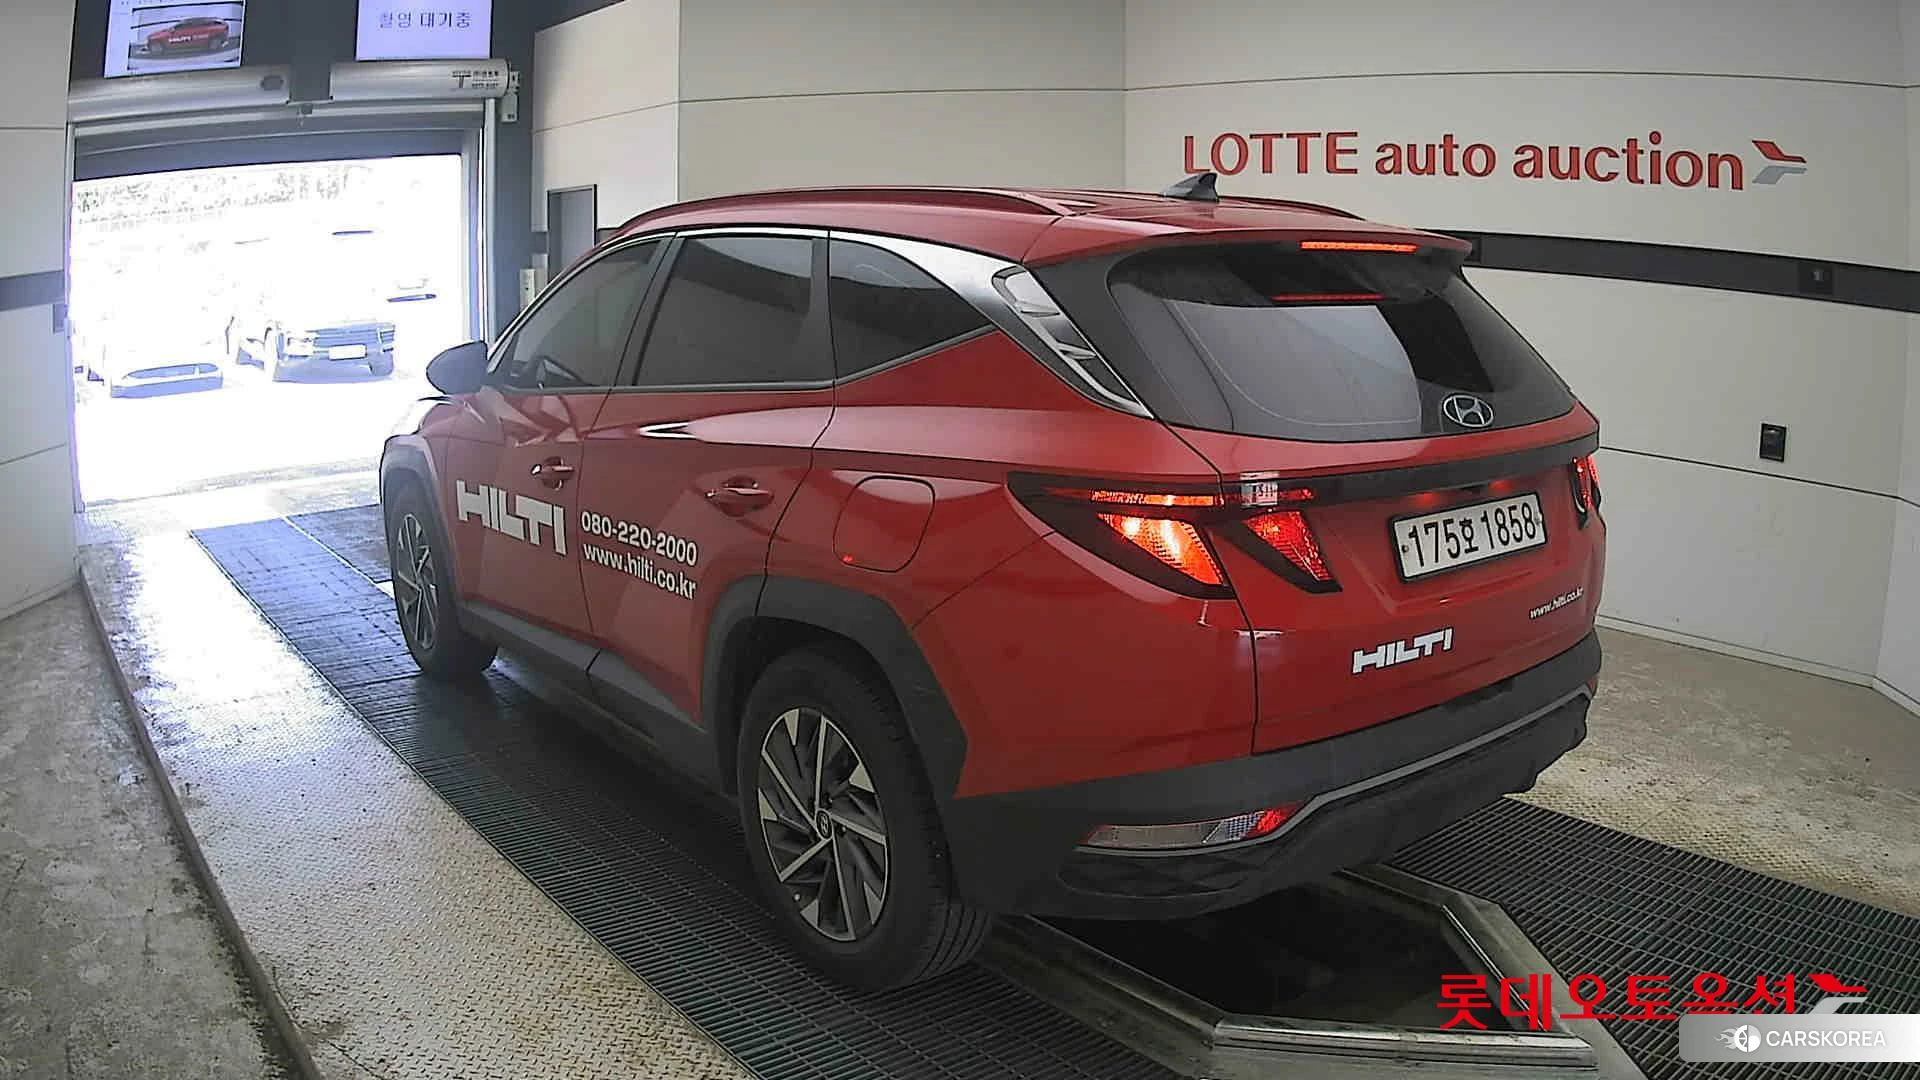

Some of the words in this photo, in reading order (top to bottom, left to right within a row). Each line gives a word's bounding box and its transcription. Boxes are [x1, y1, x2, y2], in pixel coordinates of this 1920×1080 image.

[420, 11, 472, 29] 대기중
[1184, 131, 1358, 175] LOTTE
[1375, 134, 1497, 177] auto
[1512, 130, 1744, 190] auction
[456, 479, 567, 556] HILTI
[581, 511, 697, 566] 080-220-2000
[1480, 502, 1536, 550] 1858
[583, 543, 697, 599] www.hilti.co.kr
[1352, 628, 1453, 674] HILTI
